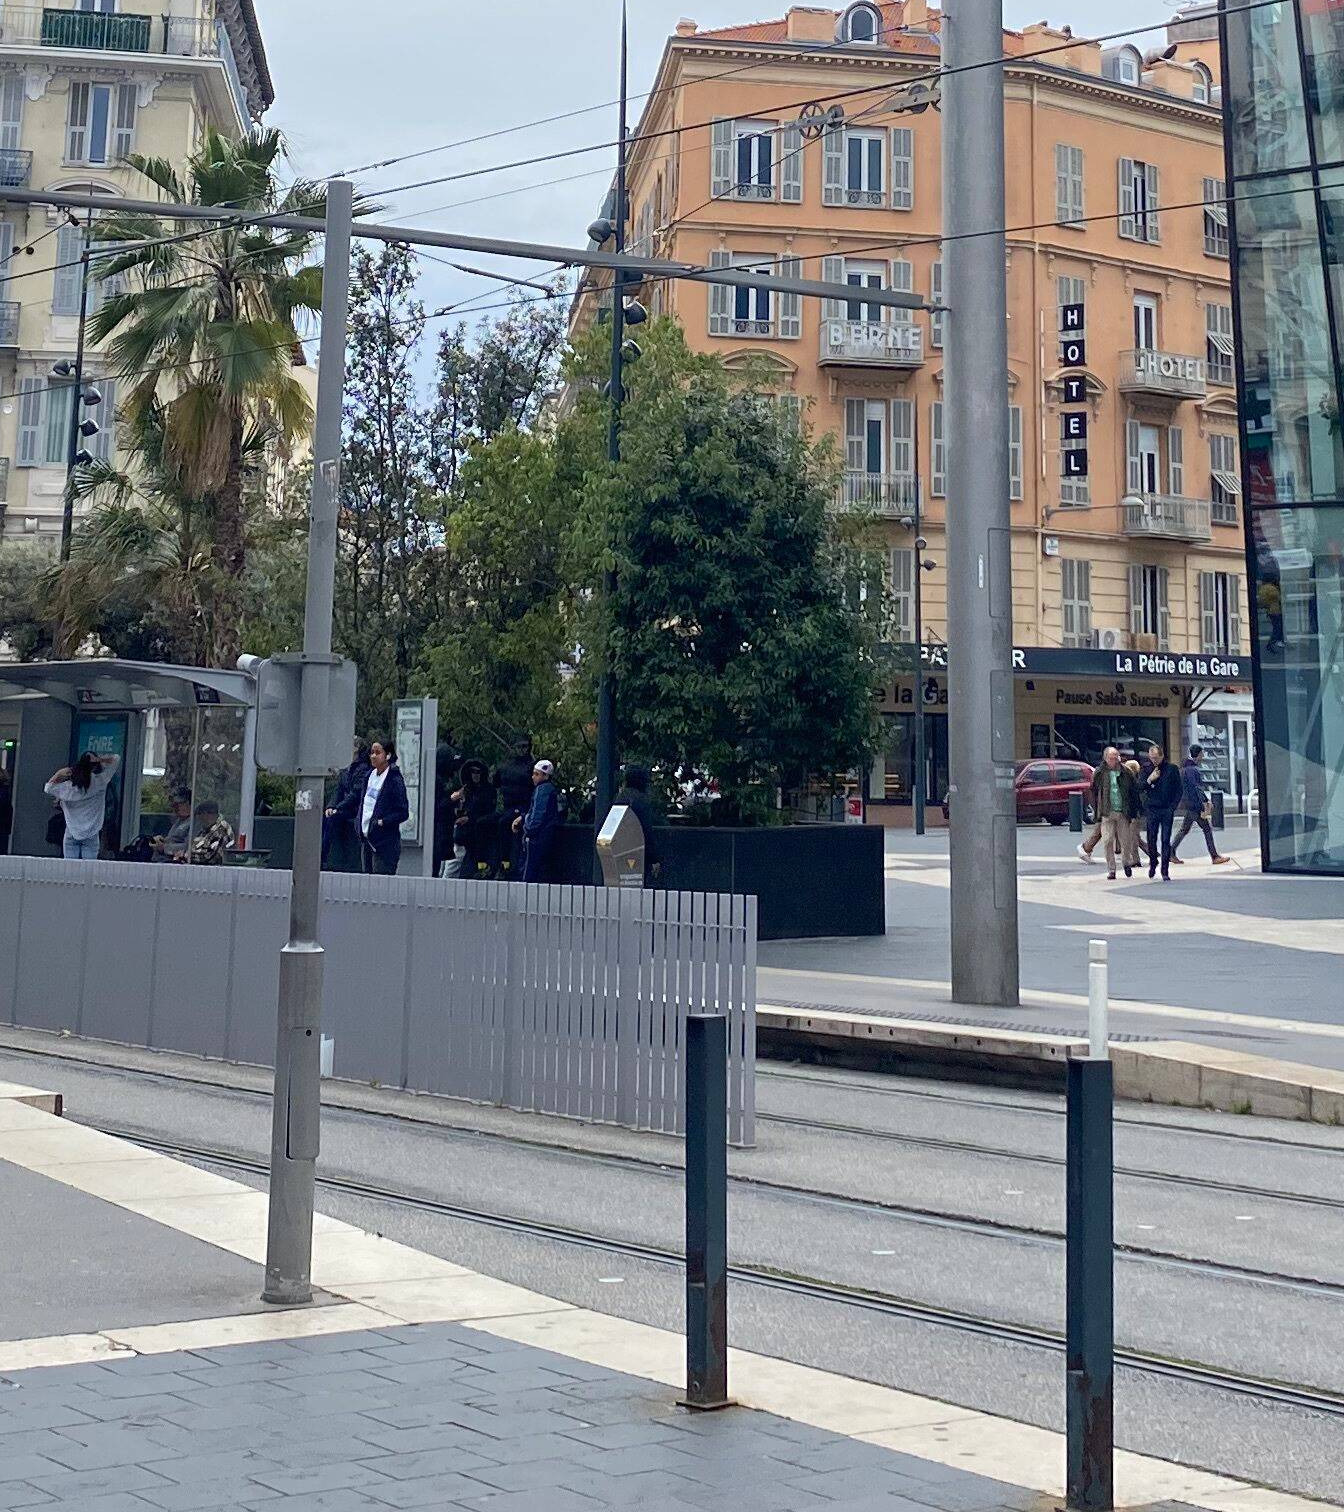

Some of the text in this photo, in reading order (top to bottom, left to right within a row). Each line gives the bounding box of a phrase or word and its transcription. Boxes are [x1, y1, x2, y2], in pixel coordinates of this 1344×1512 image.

[829, 324, 921, 350] BERNE
[1147, 352, 1206, 383] HOTEL
[1067, 309, 1080, 472] HOTEL
[1116, 653, 1239, 676] La Pétrie de la Gare
[1057, 690, 1092, 705] Pause
